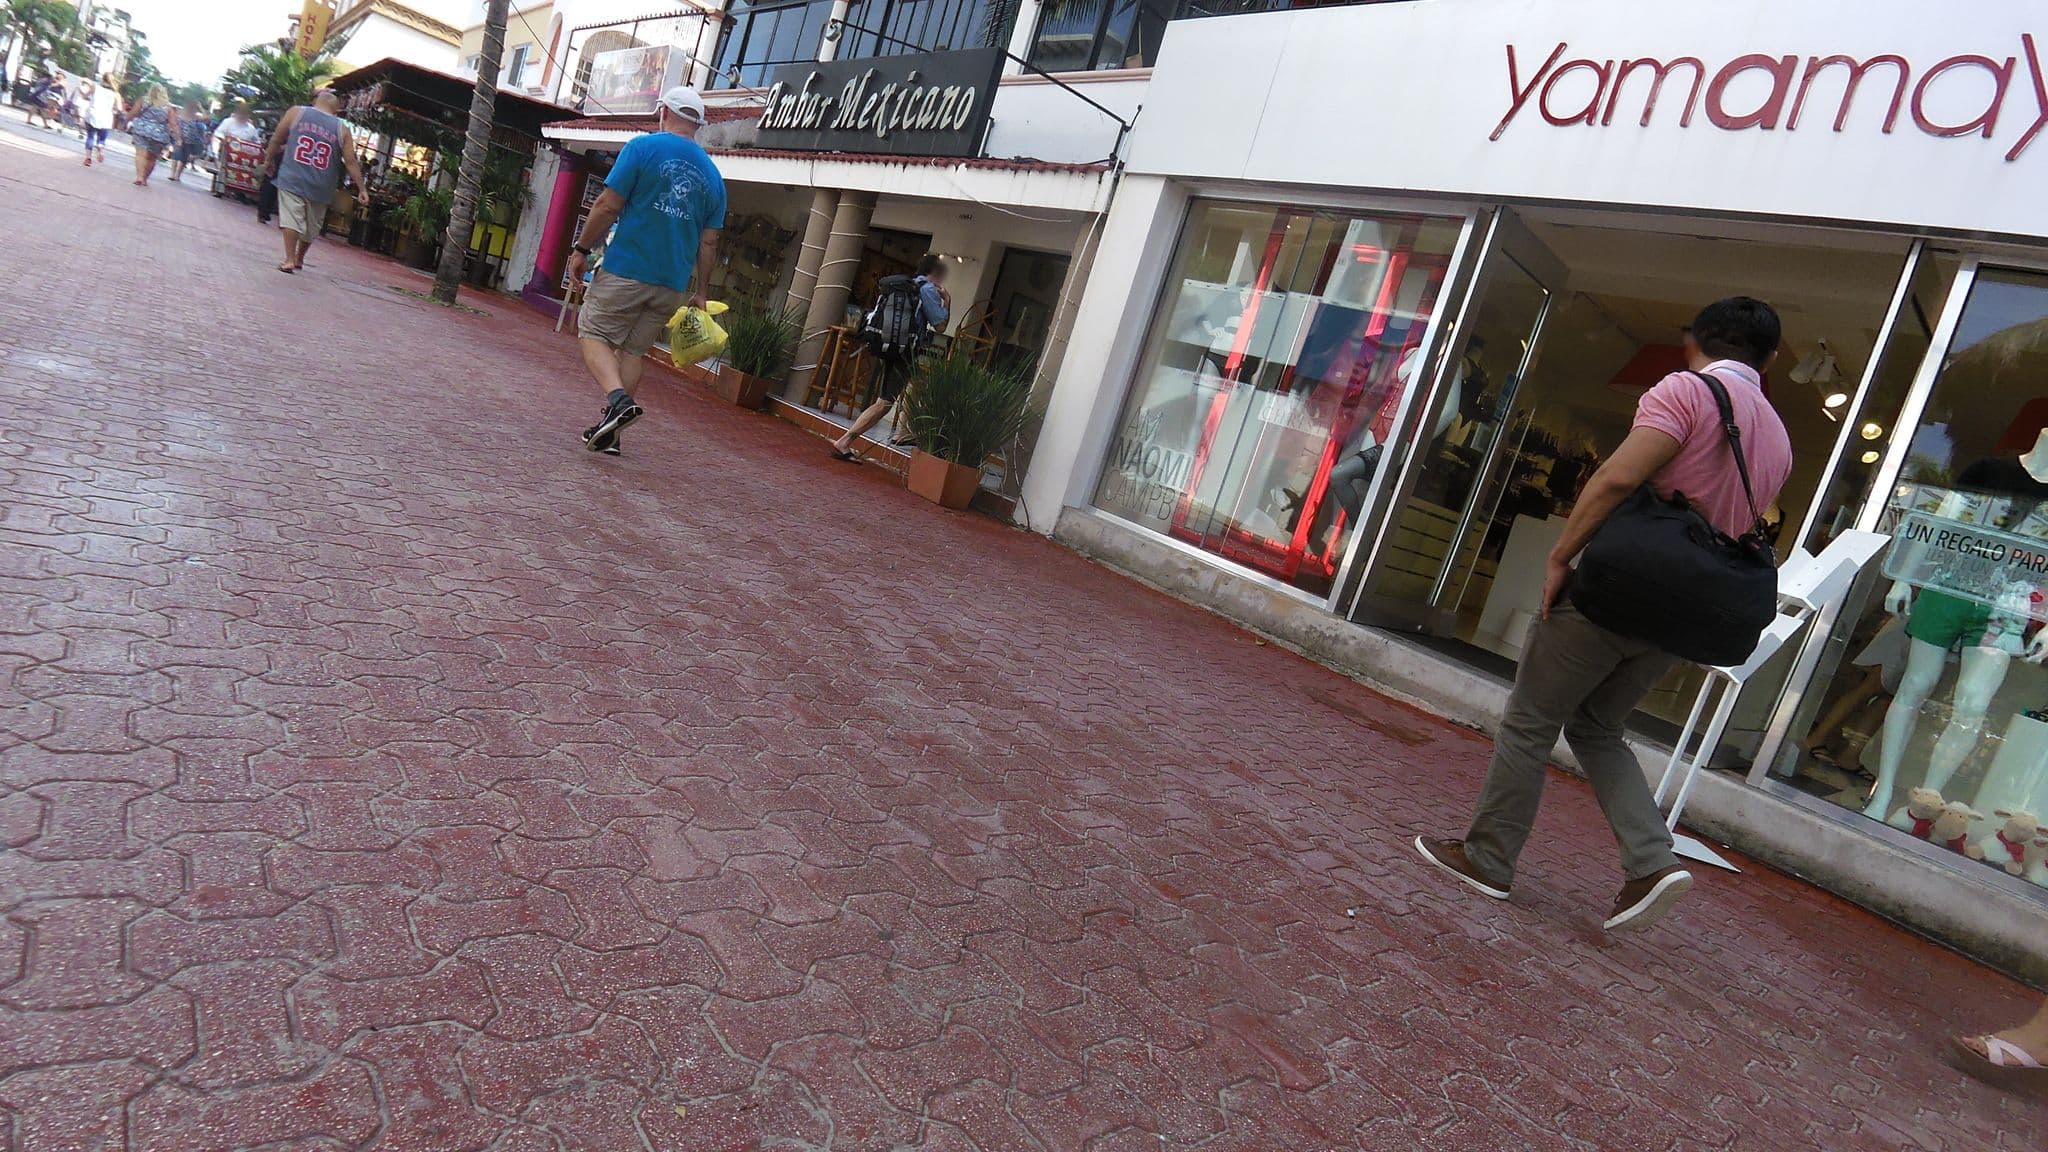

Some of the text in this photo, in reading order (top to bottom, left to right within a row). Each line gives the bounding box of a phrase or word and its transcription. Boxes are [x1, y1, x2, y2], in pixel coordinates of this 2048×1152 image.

[300, 13, 317, 60] HOTE
[756, 68, 975, 139] Ambar Mexicano
[1489, 33, 2048, 161] yamamay
[294, 135, 332, 171] 23
[1112, 437, 1193, 488] NAOMI
[1905, 522, 1934, 544] UN
[1935, 529, 2006, 562] REGALO
